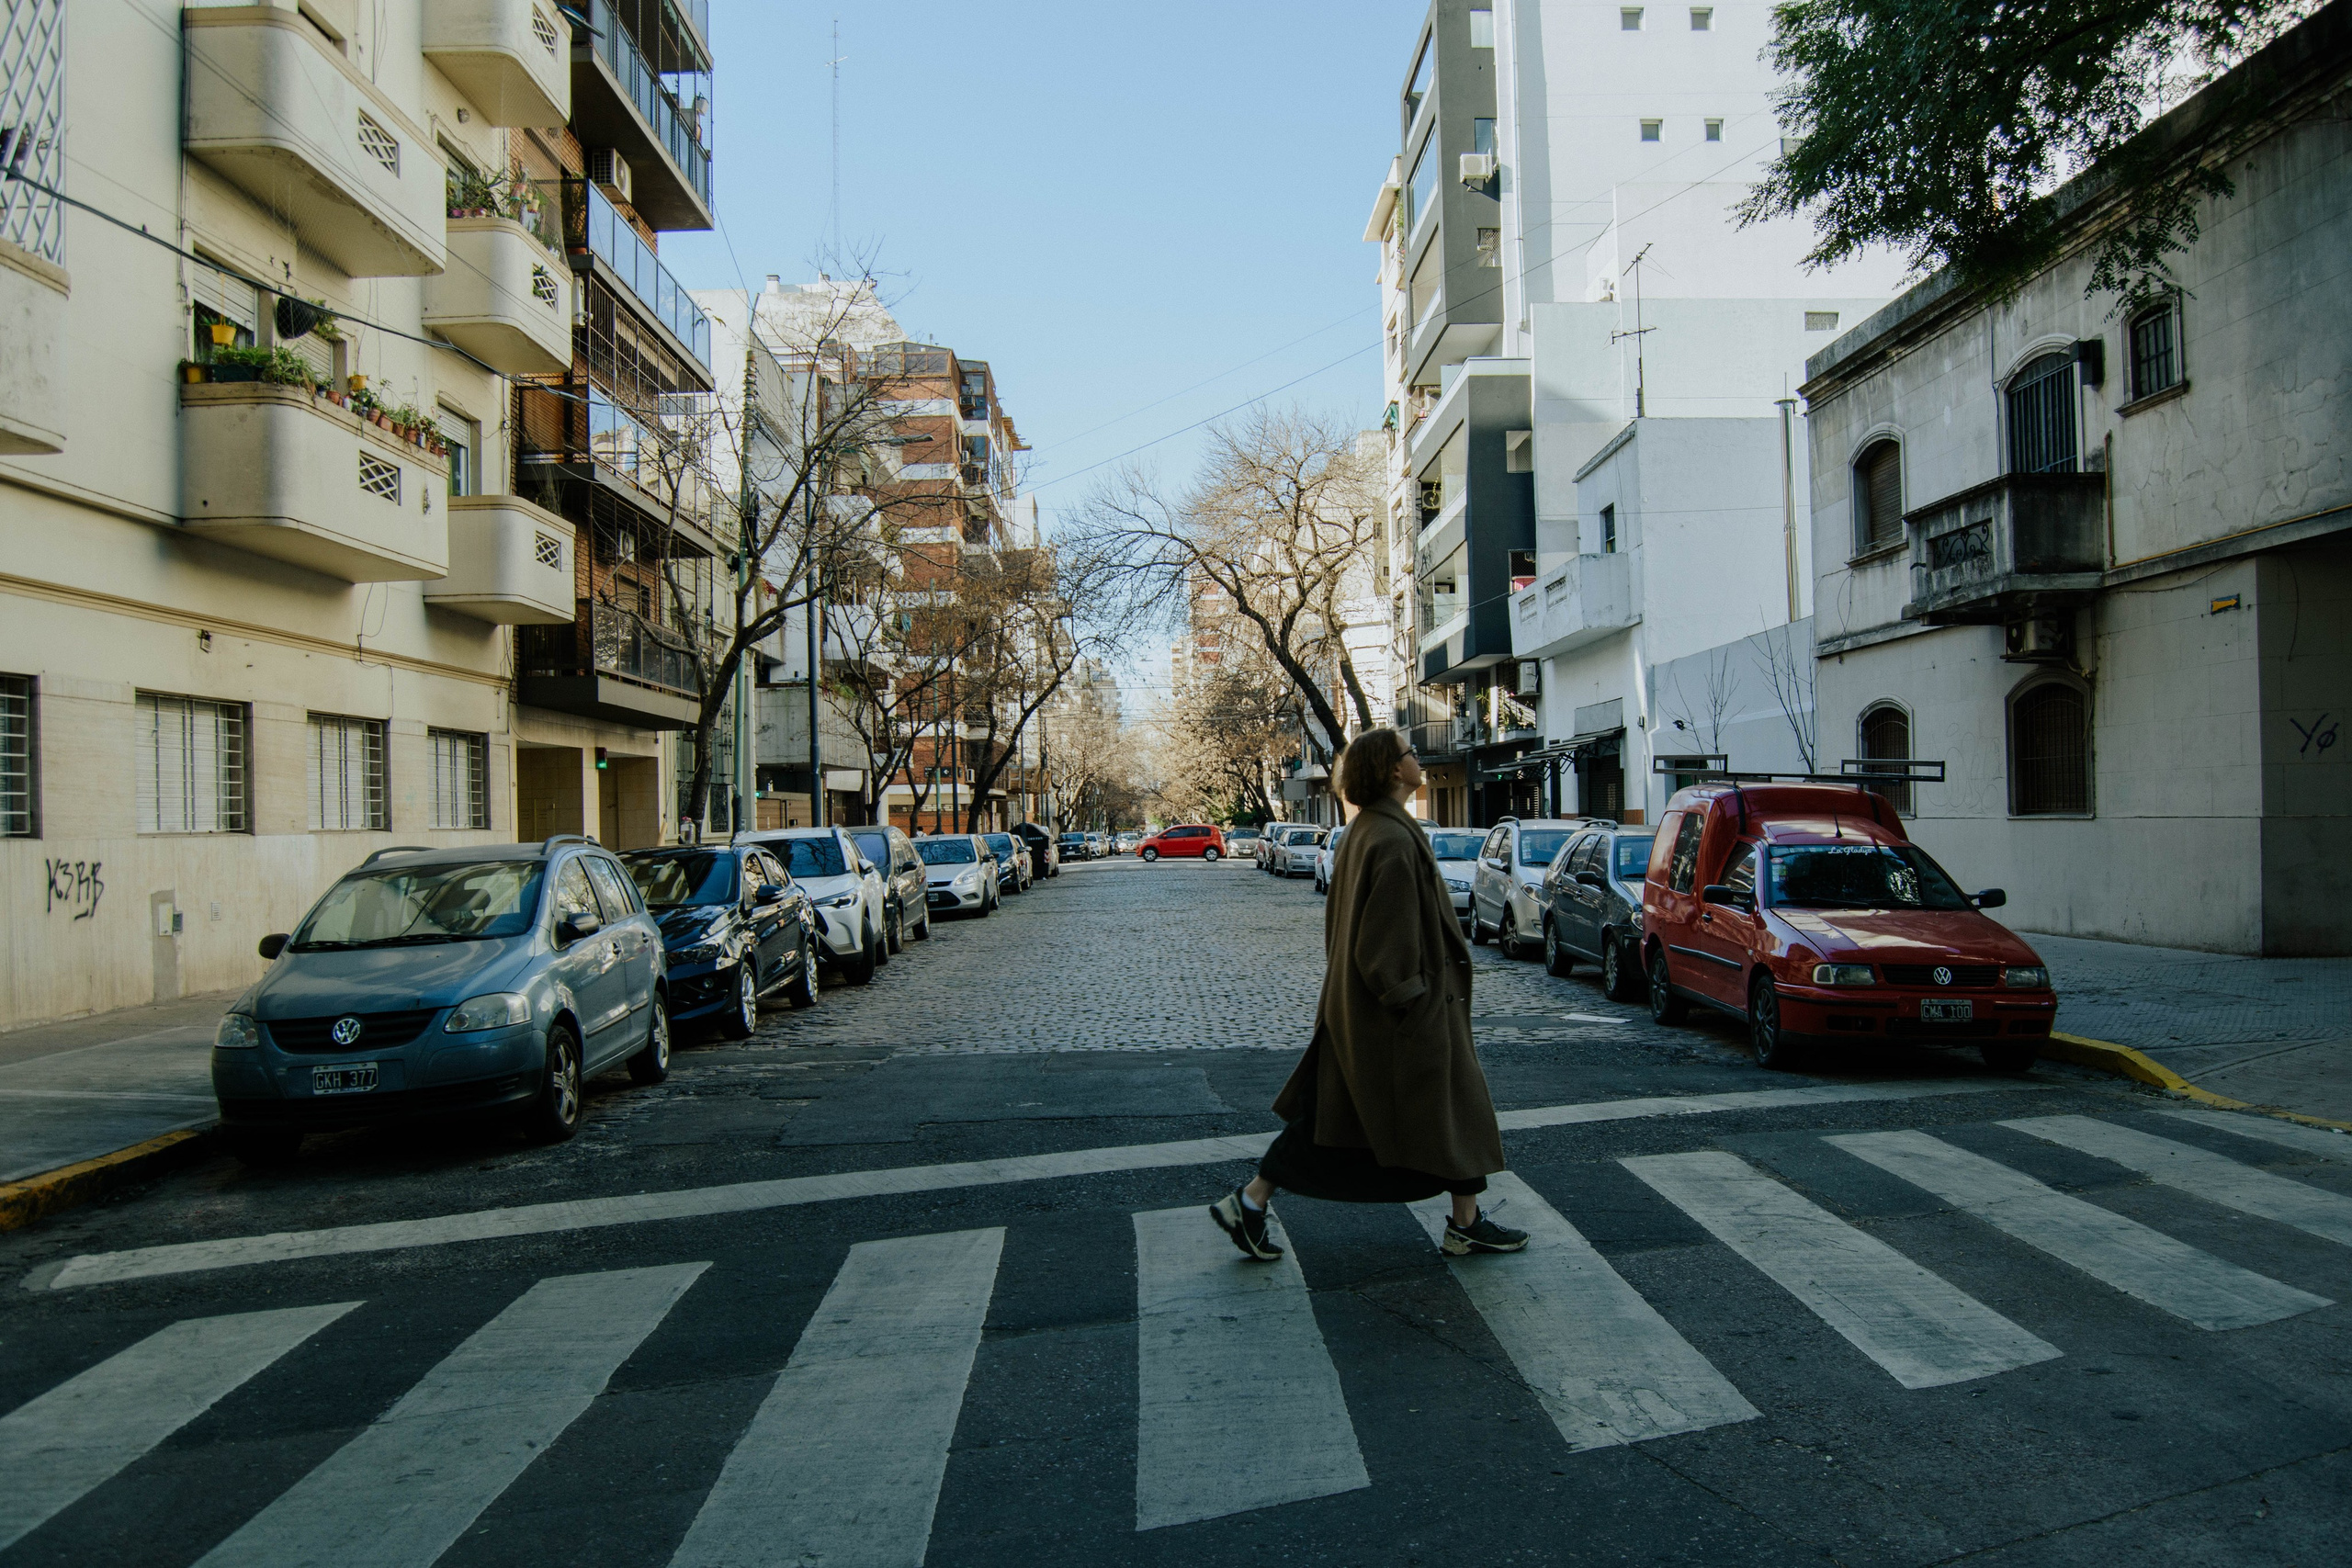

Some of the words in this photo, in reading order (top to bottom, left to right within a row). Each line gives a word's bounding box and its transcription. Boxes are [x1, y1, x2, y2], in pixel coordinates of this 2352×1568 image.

[1844, 846, 1871, 856] Gladys
[1923, 1005, 1943, 1018] CMA
[1950, 1005, 1971, 1019] 100
[316, 1072, 341, 1089] GKH
[350, 1070, 375, 1086] 377
